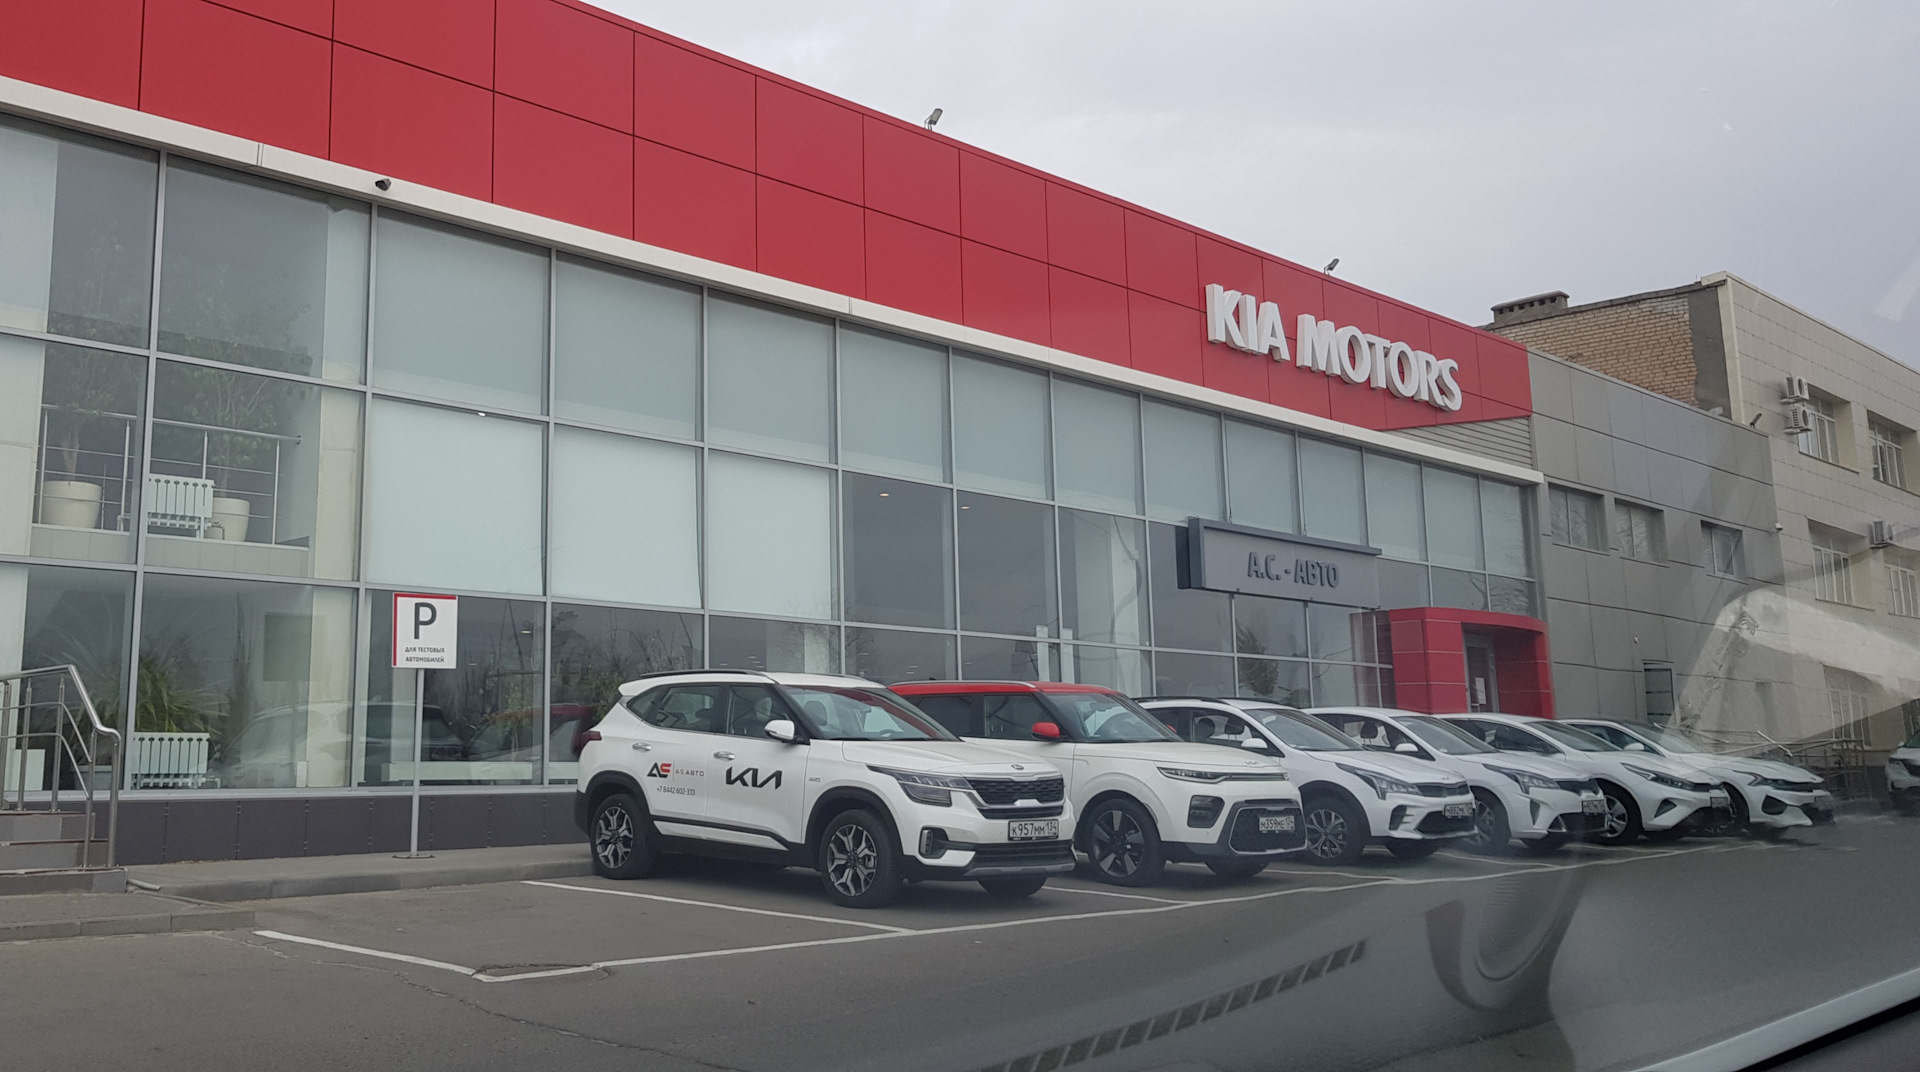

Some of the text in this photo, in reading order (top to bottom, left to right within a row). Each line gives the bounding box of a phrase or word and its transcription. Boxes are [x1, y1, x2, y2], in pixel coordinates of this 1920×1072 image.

[1205, 283, 1462, 412] KIA MOTORS
[414, 602, 437, 639] P
